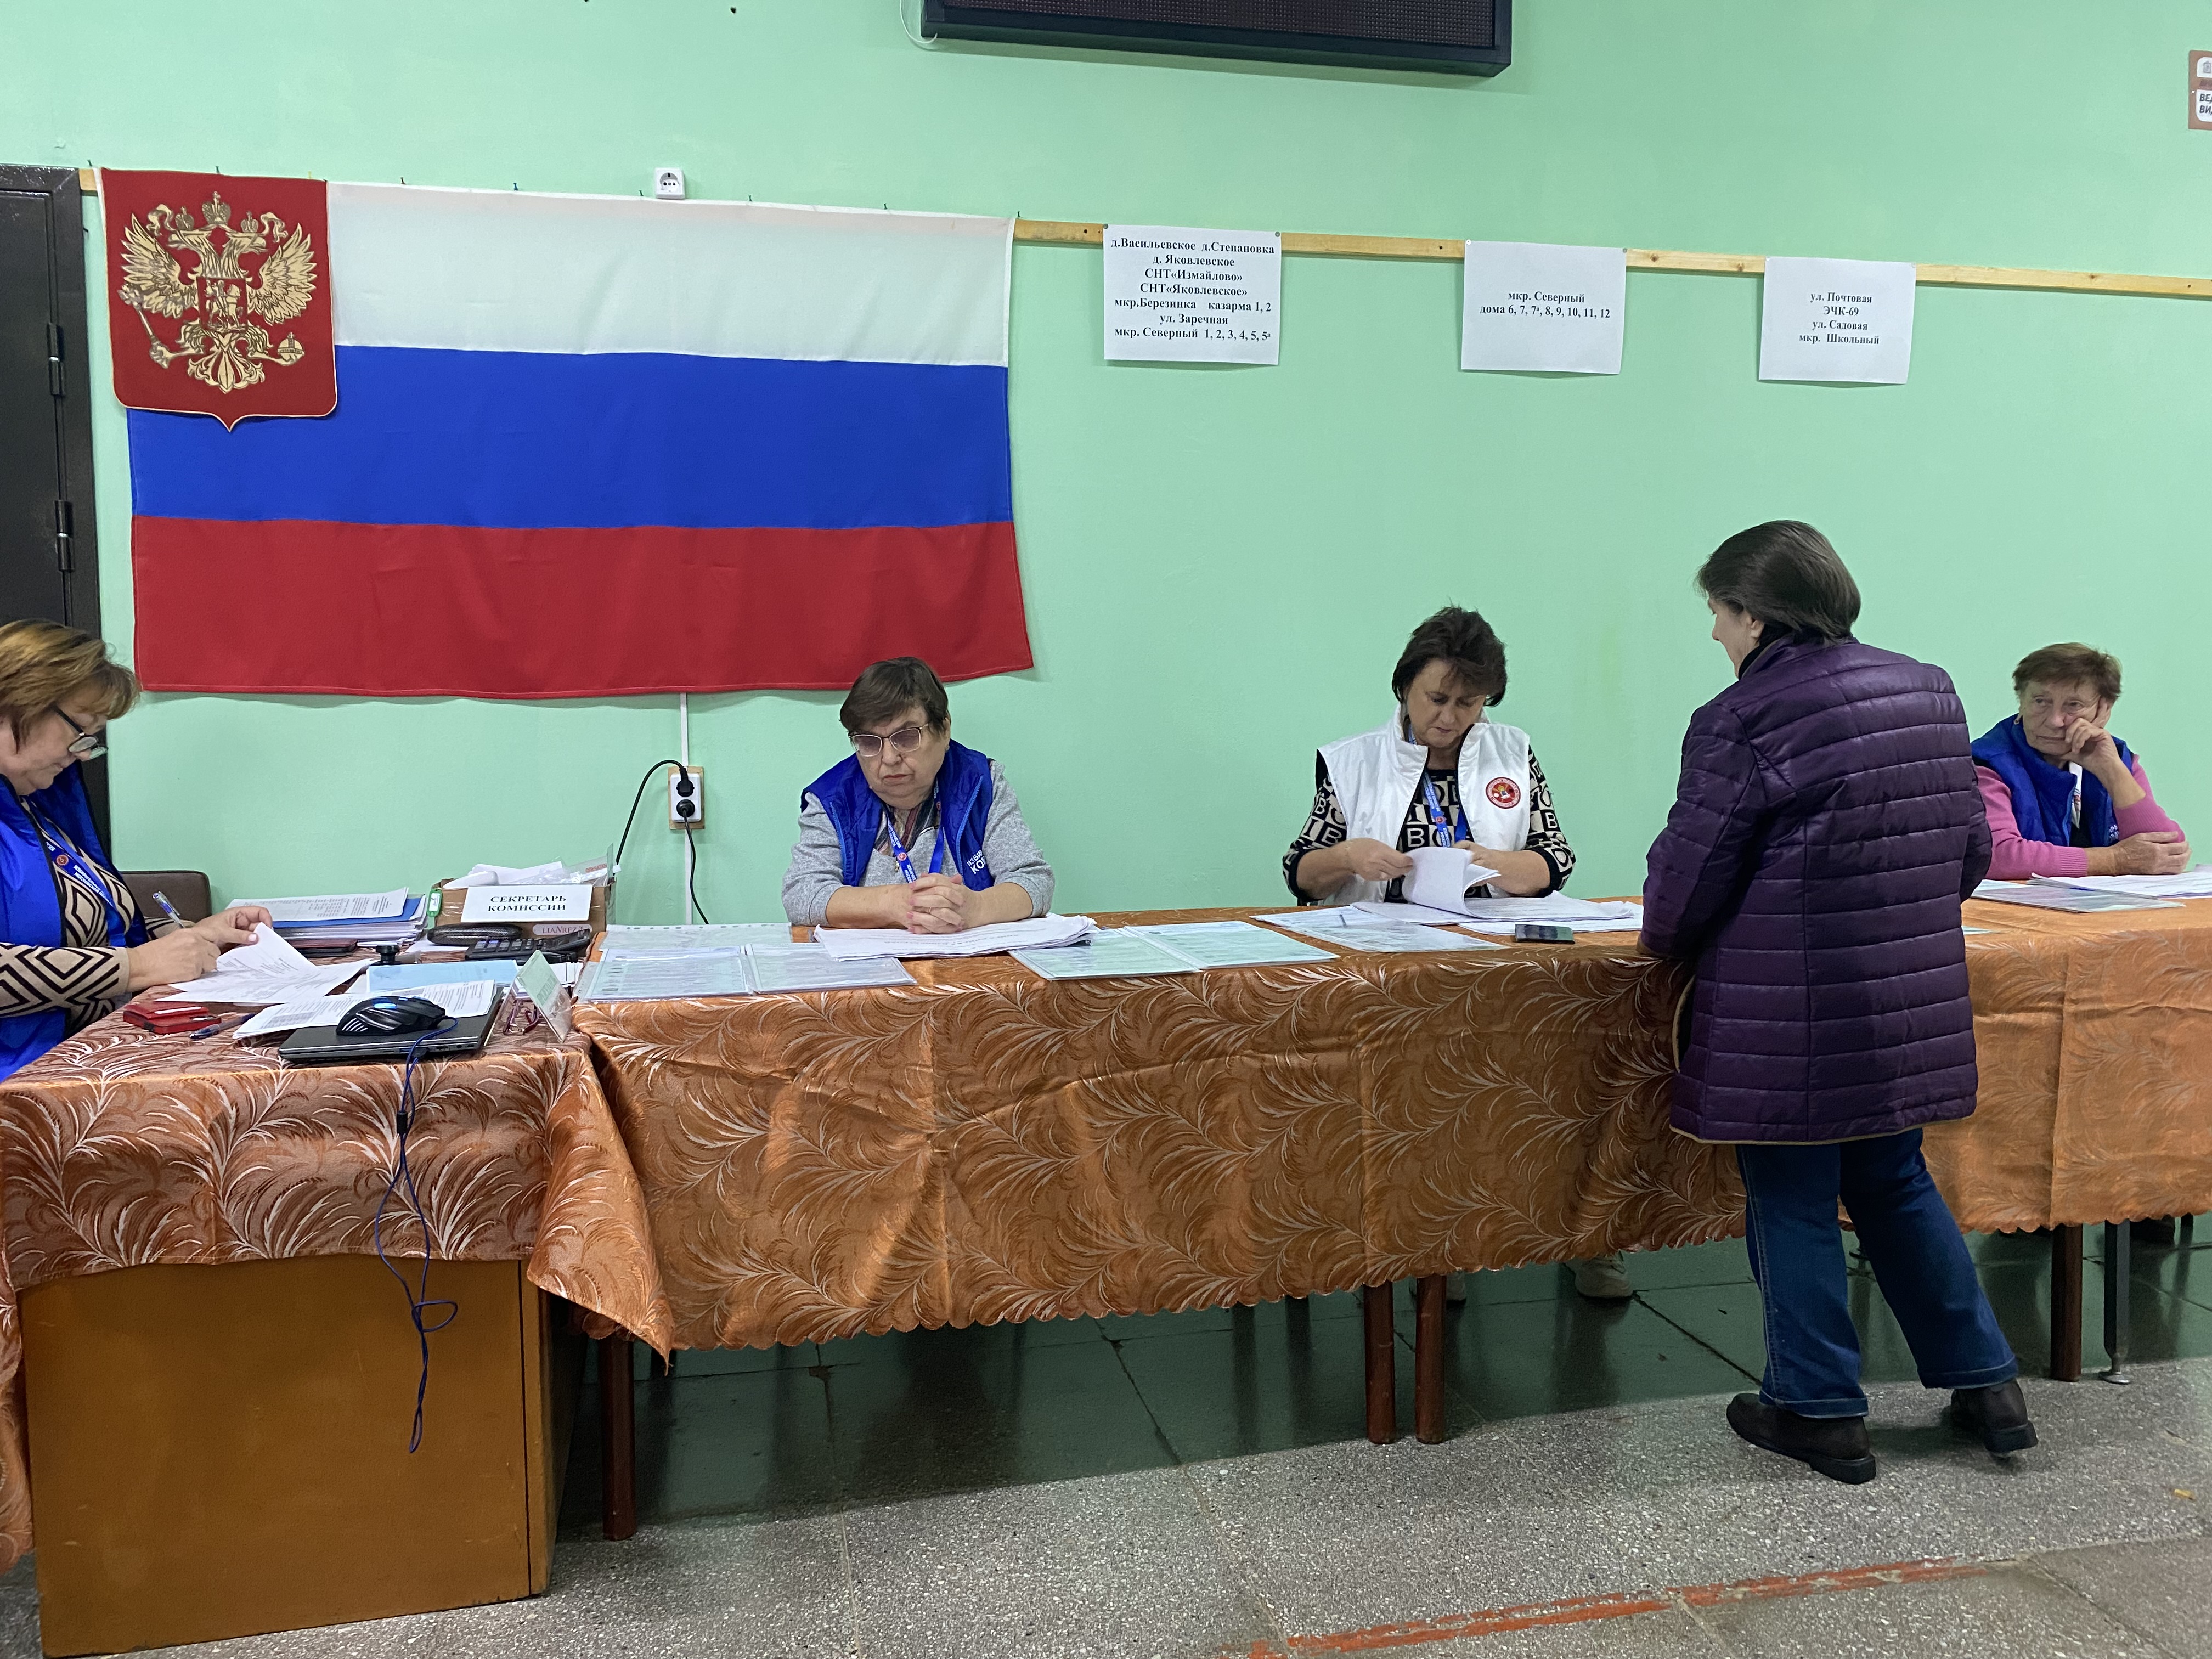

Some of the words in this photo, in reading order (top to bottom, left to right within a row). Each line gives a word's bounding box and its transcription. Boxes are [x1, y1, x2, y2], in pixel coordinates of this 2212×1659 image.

[2199, 105, 2212, 115] ВИ
[1165, 254, 1234, 266] Яковлевское
[1508, 292, 1531, 302] мкр.
[1534, 291, 1584, 304] Северный
[1810, 294, 1824, 302] ул.
[1827, 292, 1872, 303] Почтовая
[1208, 302, 1251, 313] казарма
[1255, 302, 1263, 313] 1,
[1266, 302, 1271, 312] 2
[1508, 304, 1516, 315] 6,
[1520, 305, 1528, 315] 7,
[1545, 306, 1553, 317] 8,
[1556, 306, 1564, 317] 9,
[1568, 307, 1581, 318] 10,
[1584, 308, 1596, 319] 11,
[1601, 309, 1610, 318] 12
[1823, 306, 1859, 315] ЭЧК-69
[1159, 315, 1175, 325] ул.
[1178, 313, 1228, 325] Заречная
[1812, 321, 1826, 330] ул.
[1829, 319, 1867, 330] Садовая
[1115, 329, 1139, 338] мкр.
[1143, 327, 1197, 340] Северный
[1206, 329, 1212, 340] 1,
[1216, 329, 1224, 340] 2,
[1227, 329, 1236, 340] 3,
[1239, 330, 1248, 341] 4,
[1250, 330, 1259, 342] 5,
[1799, 335, 1820, 344] мкр.
[1826, 333, 1878, 344] Школьный
